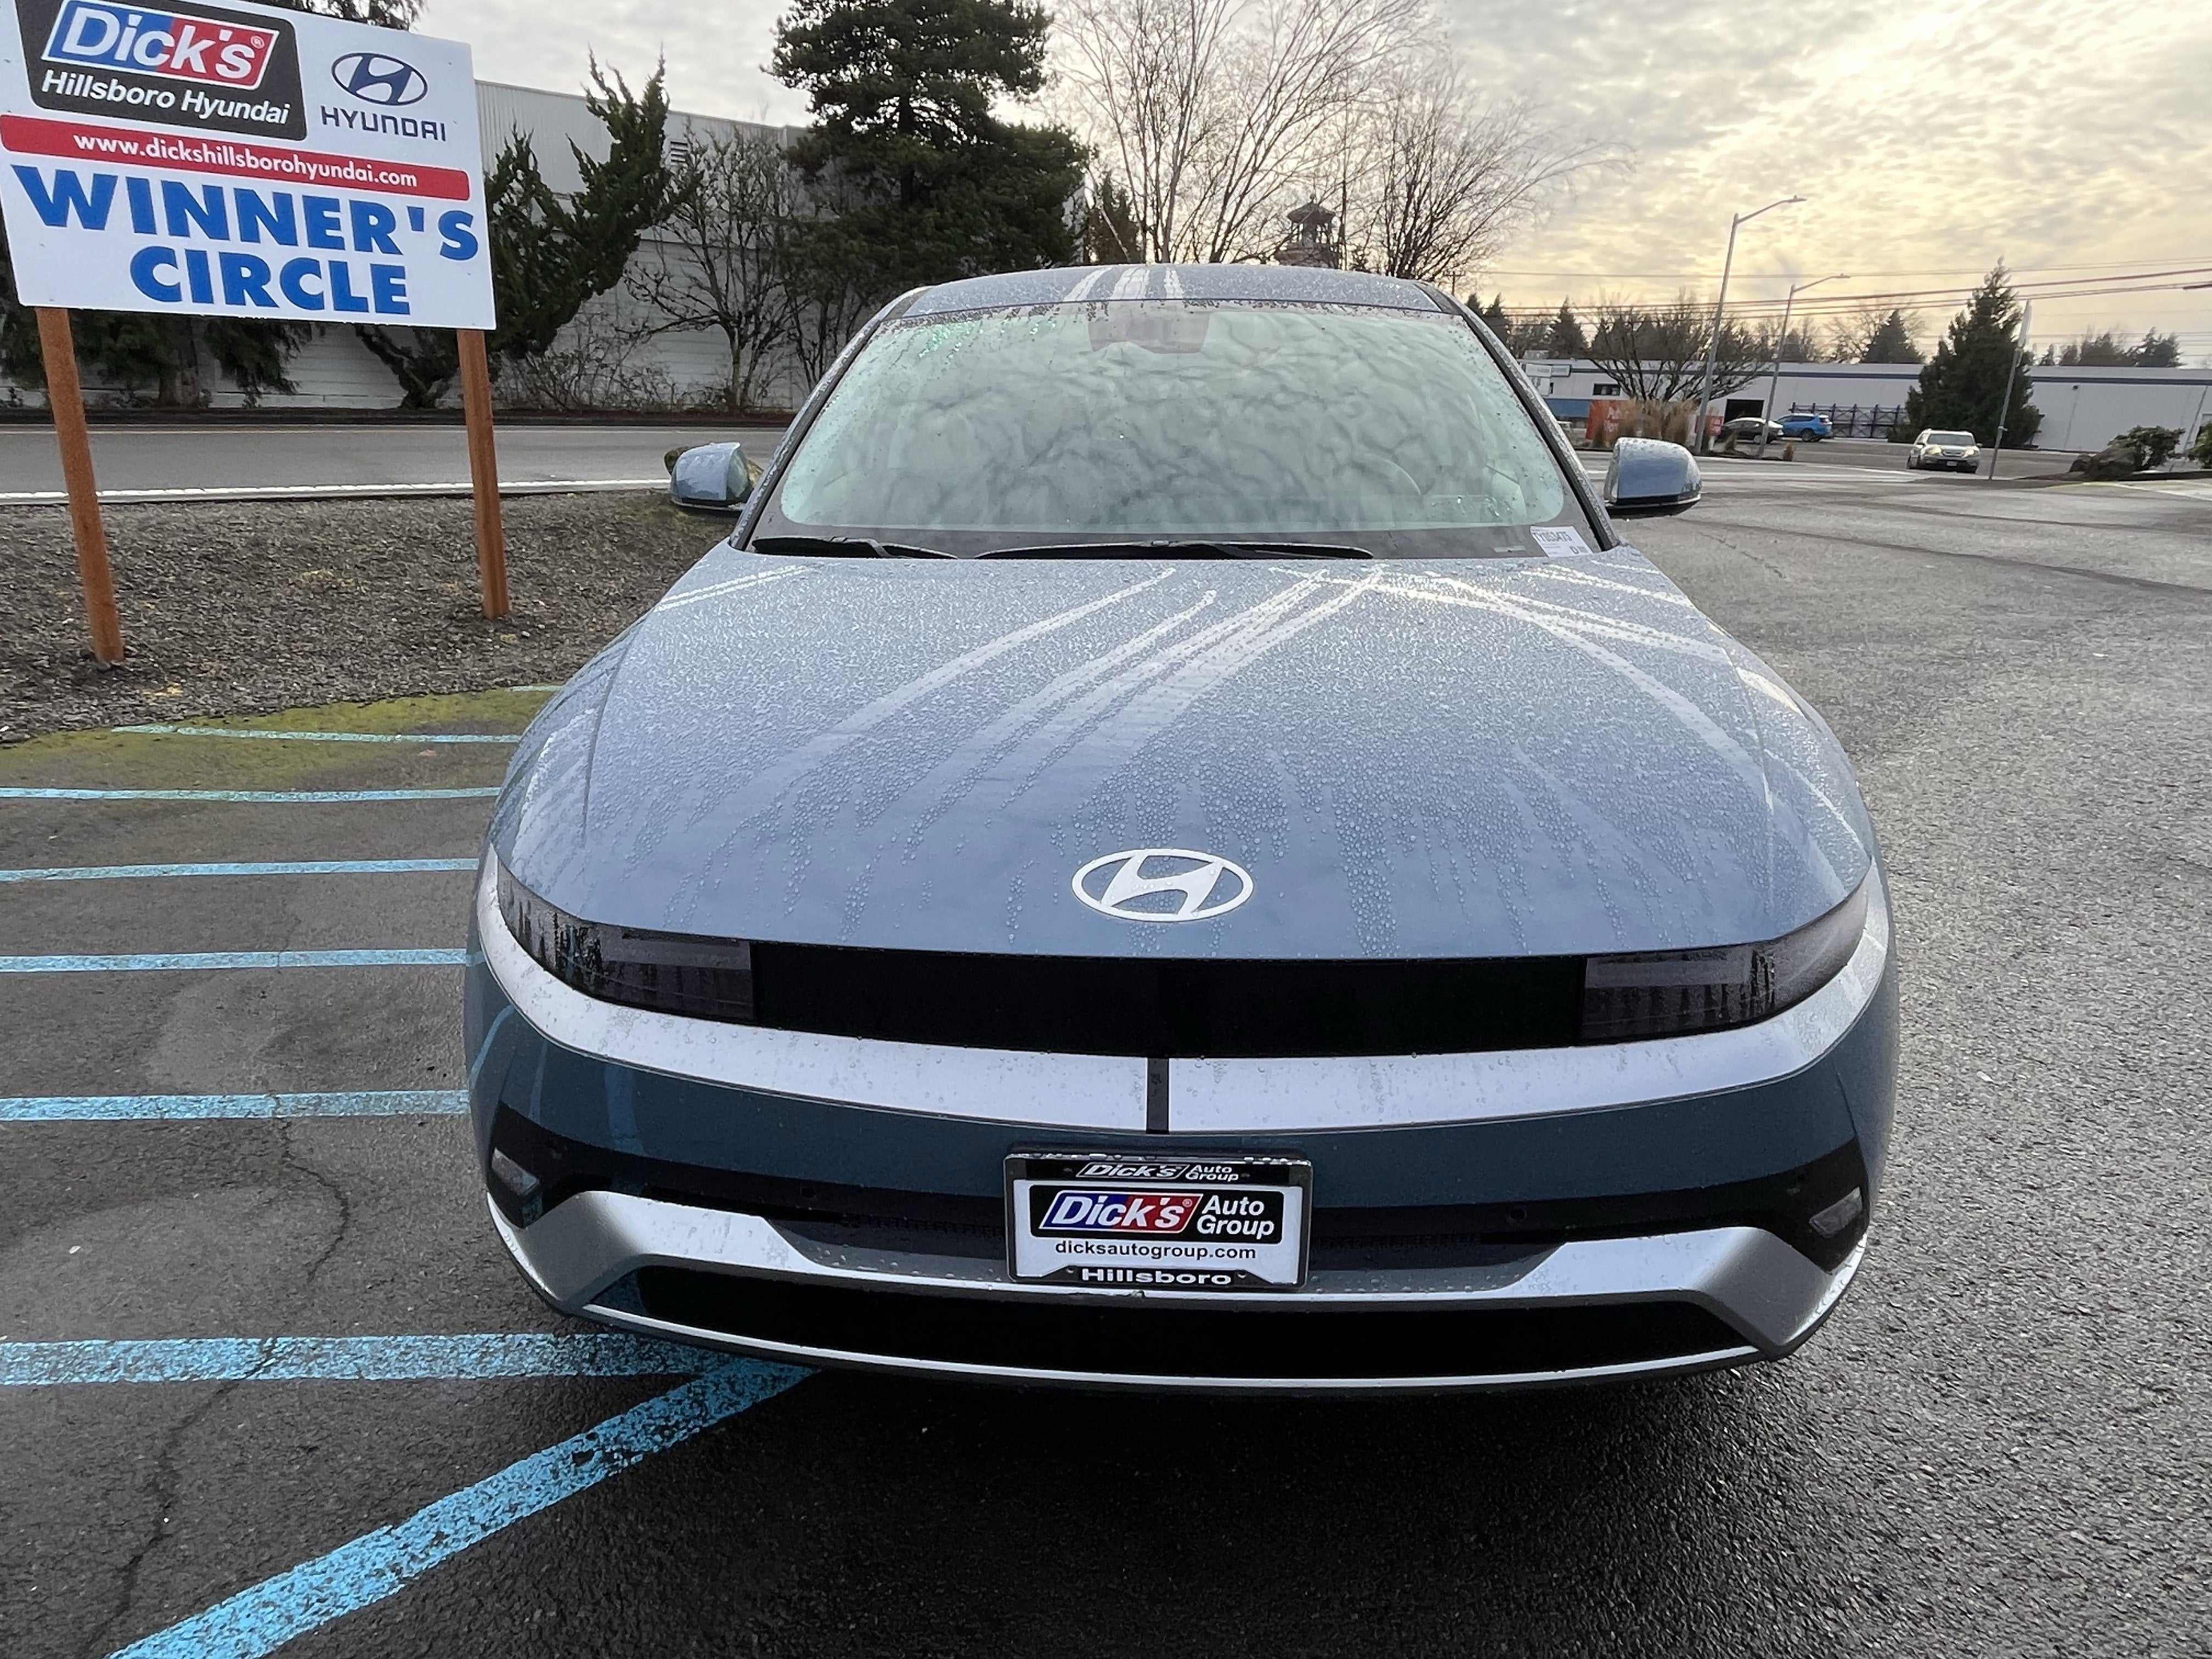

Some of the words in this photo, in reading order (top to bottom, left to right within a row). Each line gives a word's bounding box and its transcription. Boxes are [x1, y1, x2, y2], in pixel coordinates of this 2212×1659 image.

[61, 6, 256, 79] Dick's
[42, 69, 175, 109] Hillsboro
[181, 89, 291, 125] Hyundai
[321, 106, 447, 142] HYUNDAI
[73, 133, 417, 188] www.dickshillsborohyundai.com
[11, 165, 479, 261] WINNER'S
[129, 246, 410, 315] CIRCLE
[1084, 1163, 1176, 1178] Dick's
[1192, 1164, 1232, 1173] Auto
[1185, 1172, 1239, 1182] Group
[1051, 1195, 1184, 1228] Dick's
[1202, 1195, 1265, 1216] Auto
[1197, 1216, 1274, 1240] Group
[1055, 1239, 1256, 1260] dicksautogroup.com
[1082, 1268, 1232, 1285] Hillsboro
